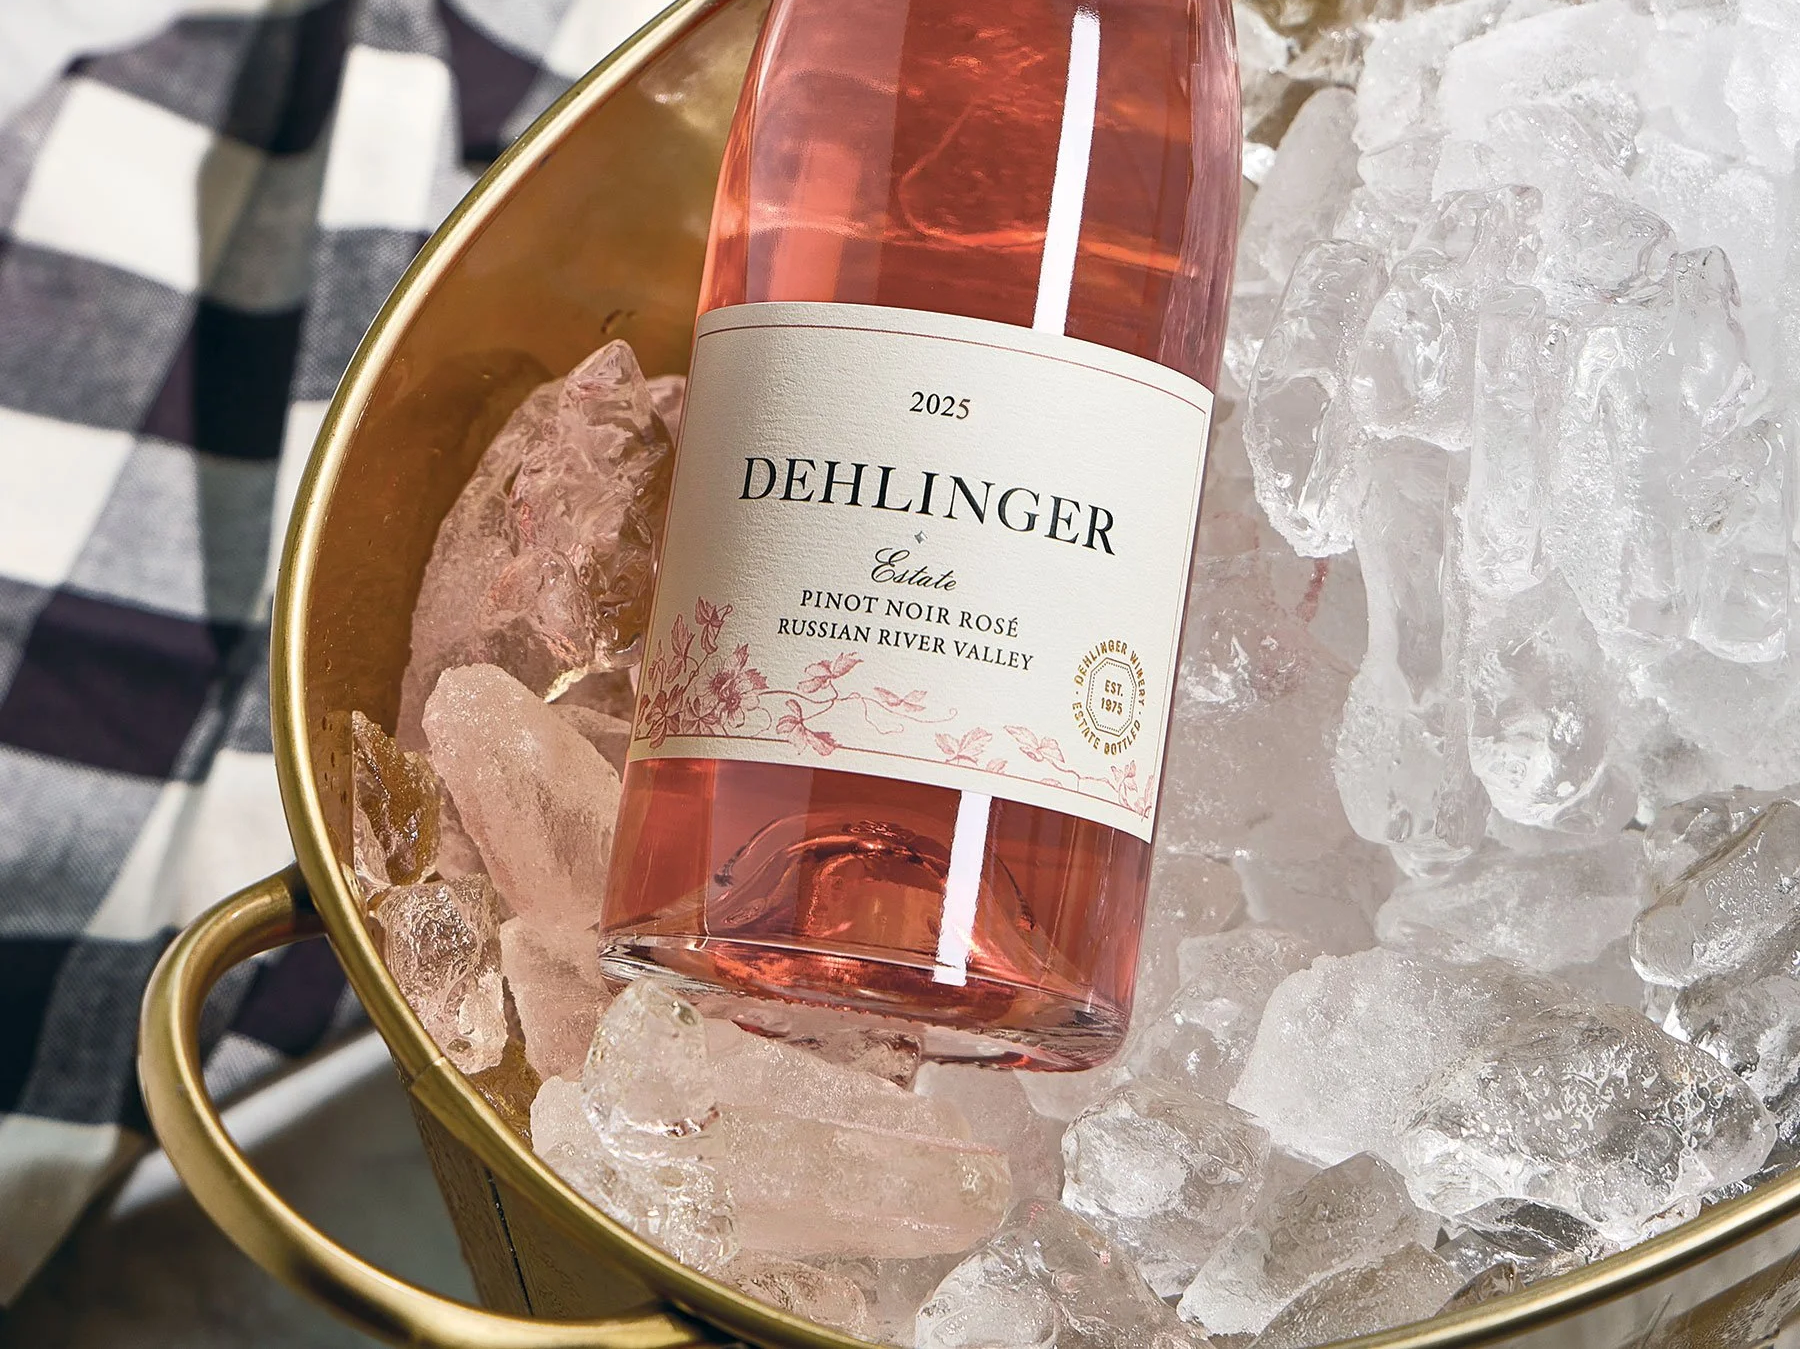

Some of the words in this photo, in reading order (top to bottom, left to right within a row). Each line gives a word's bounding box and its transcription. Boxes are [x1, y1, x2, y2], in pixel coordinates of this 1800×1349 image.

[909, 391, 971, 420] 2025
[738, 456, 1116, 556] DEHLINGER
[870, 547, 960, 592] Estate
[800, 589, 879, 614] PINOT
[886, 599, 951, 626] NOIR
[959, 611, 1020, 638] ROSÉ
[777, 618, 872, 643] RUSSIAN
[877, 629, 946, 655] RIVER
[953, 640, 1034, 671] VALLEY
[1073, 639, 1128, 687] DEHLINGER
[1129, 650, 1146, 707] WINERY
[1104, 679, 1124, 697] EST.
[1072, 701, 1101, 750] ESTATE
[1103, 719, 1141, 756] BOTTLED
[1100, 697, 1123, 716] 1975
